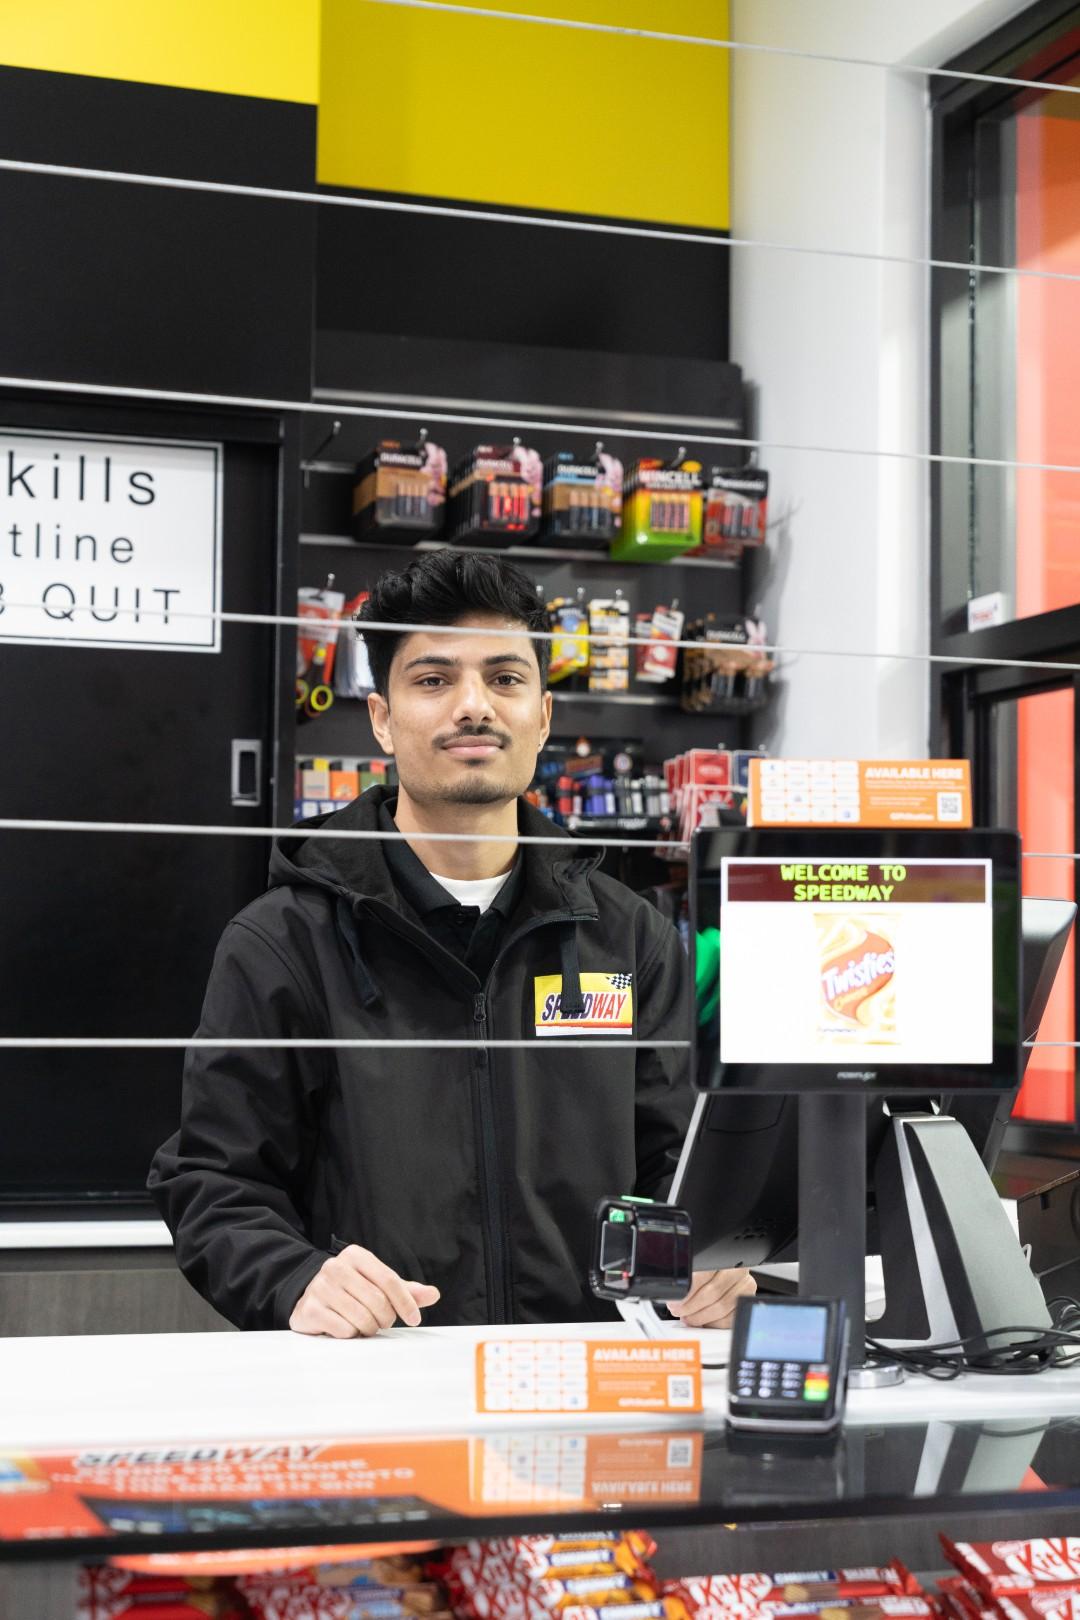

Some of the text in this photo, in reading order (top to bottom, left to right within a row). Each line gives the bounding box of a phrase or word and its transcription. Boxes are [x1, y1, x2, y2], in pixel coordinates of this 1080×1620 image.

[8, 450, 156, 506] kills
[8, 522, 135, 564] tline
[42, 583, 181, 625] QUIT
[865, 768, 963, 780] AVAILABLE HERE
[780, 864, 907, 881] WELCOME TO
[793, 884, 894, 902] SPEEDWAY
[820, 951, 896, 1000] Twisties
[593, 1348, 696, 1361] AVAILABLE HERE
[78, 1441, 324, 1468] SPEEDWAY
